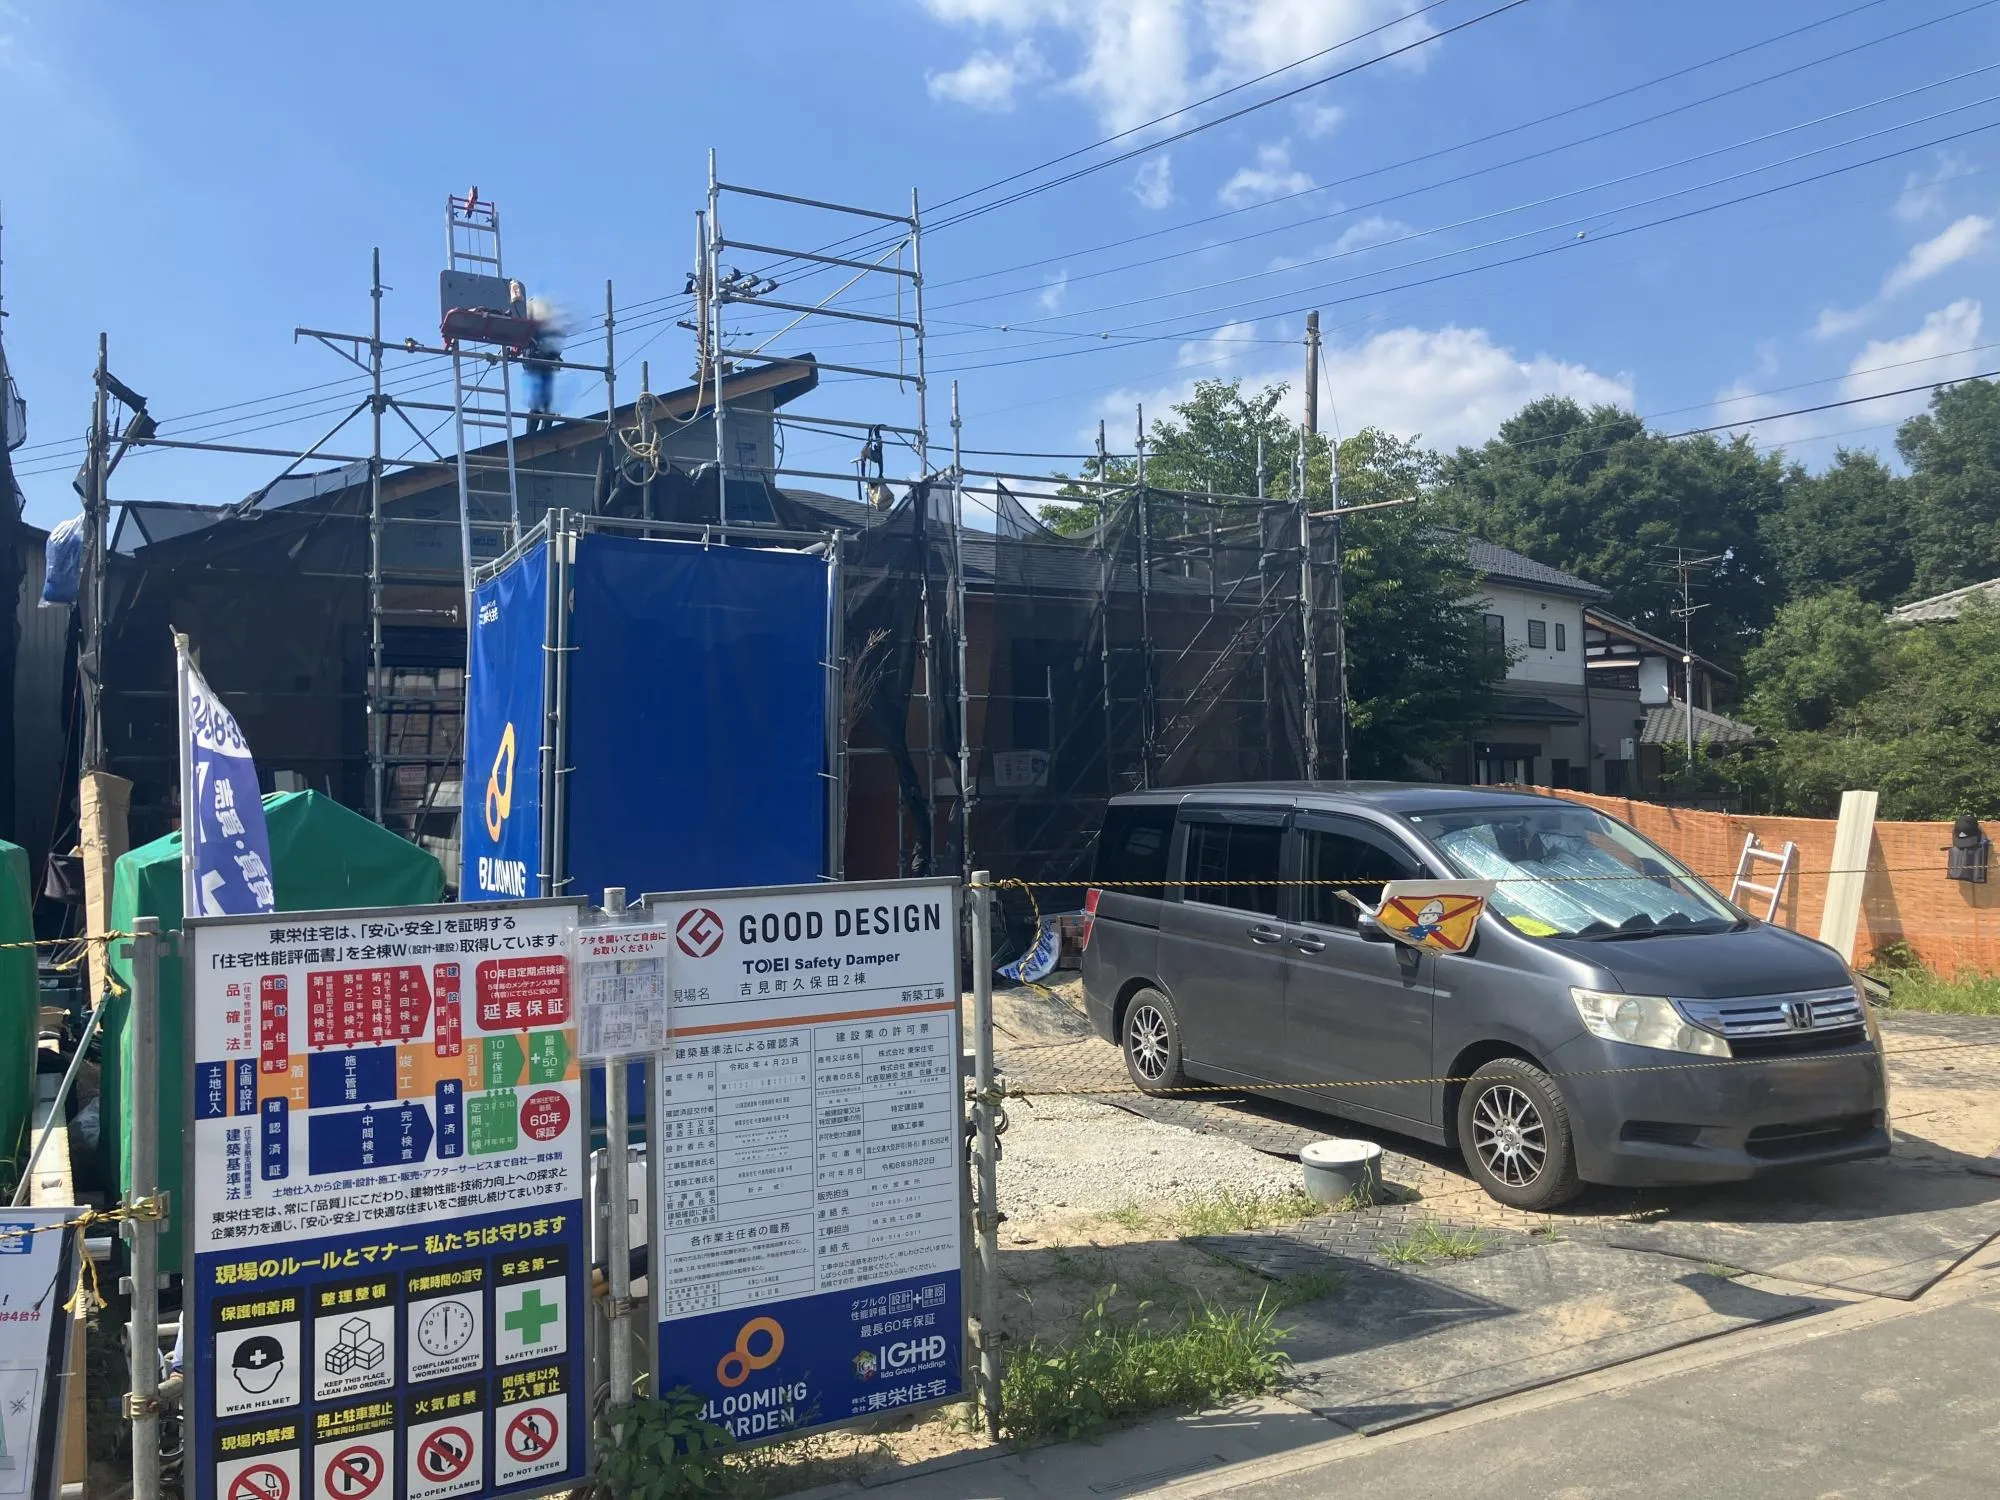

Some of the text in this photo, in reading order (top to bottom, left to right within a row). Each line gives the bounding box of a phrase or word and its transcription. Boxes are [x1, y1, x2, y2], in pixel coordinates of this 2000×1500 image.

[270, 918, 516, 943] 東栄住宅は、「安心・安全」を証明する
[740, 904, 940, 944] GOOD DESIGN
[593, 944, 654, 955] お取りください
[484, 965, 566, 979] 10年目定期点検後
[794, 956, 841, 972] Safety
[846, 952, 900, 967] Damper
[740, 972, 867, 996] 吉見町久保田2棟
[901, 988, 944, 1002] 新築工事
[313, 976, 325, 1041] 第1回検査
[343, 975, 354, 1039] 第2回検査
[372, 973, 383, 1037] 第3回検査
[400, 971, 410, 1034] 第4回検査
[436, 968, 446, 1055] 性能評価書
[484, 998, 564, 1020] 延長保証
[226, 983, 240, 1051] 品確法
[262, 980, 274, 1070] 性能評価書
[836, 1024, 929, 1042] 建設業の許可票
[676, 1037, 799, 1059] 建築基準法による確認済
[399, 1056, 413, 1089] 竣工
[491, 1040, 504, 1084] 10年保証
[239, 1063, 252, 1111] 企画・設計
[290, 1065, 304, 1100] 着工
[345, 1055, 357, 1099] 施工管理
[818, 1073, 860, 1082] 代表者の氏名
[208, 1067, 221, 1114] 土地仕入
[443, 1084, 456, 1155] 検査済証
[530, 1112, 561, 1126] 60年
[268, 1102, 281, 1176] 確認済証
[362, 1115, 374, 1164] 中間検査
[401, 1111, 413, 1159] 完了検査
[536, 1127, 556, 1138] 保証
[226, 1129, 240, 1200] 建築基準法
[818, 1189, 849, 1200] 販売担当
[818, 1207, 850, 1218] 連絡先
[691, 1222, 790, 1247] 各作業主任者の職務
[818, 1224, 850, 1236] 工事担当
[215, 1216, 566, 1284] 現場のルールとマナー 私たちは守ります
[818, 1242, 850, 1254] 連絡先
[502, 1258, 559, 1277] 安全第一
[408, 1268, 482, 1292] 作業時間の遵守
[321, 1284, 386, 1307] 整理整頓
[852, 1296, 886, 1310] ダブルの
[221, 1298, 295, 1321] 保護帽着用
[851, 1306, 887, 1321] 性能評価
[860, 1313, 935, 1338] 最長60年保証
[412, 1354, 479, 1372] COMPLIANCE WITH
[505, 1345, 558, 1360] SAFETY FIRST
[881, 1335, 946, 1369] IGHD
[363, 1372, 385, 1381] PLACE
[415, 1362, 477, 1378] WORKING HOURS
[503, 1367, 559, 1388] 関係者以外
[895, 1365, 916, 1376] Group
[918, 1360, 946, 1371] Holdings
[318, 1378, 391, 1397] CLEAN AND ORDERLY
[503, 1381, 560, 1402] 立入禁止
[868, 1379, 947, 1410] 東栄住宅
[226, 1397, 291, 1412] WEAR HELMET
[415, 1391, 476, 1414] 火気厳禁
[317, 1402, 393, 1428] 路上駐車禁止
[723, 1407, 794, 1438] ARDEN
[221, 1426, 295, 1450] 現場内禁煙
[517, 1467, 532, 1476] NOT
[535, 1461, 560, 1472] ENTER
[425, 1486, 447, 1496] OPEN
[449, 1479, 480, 1491] FLAMES
